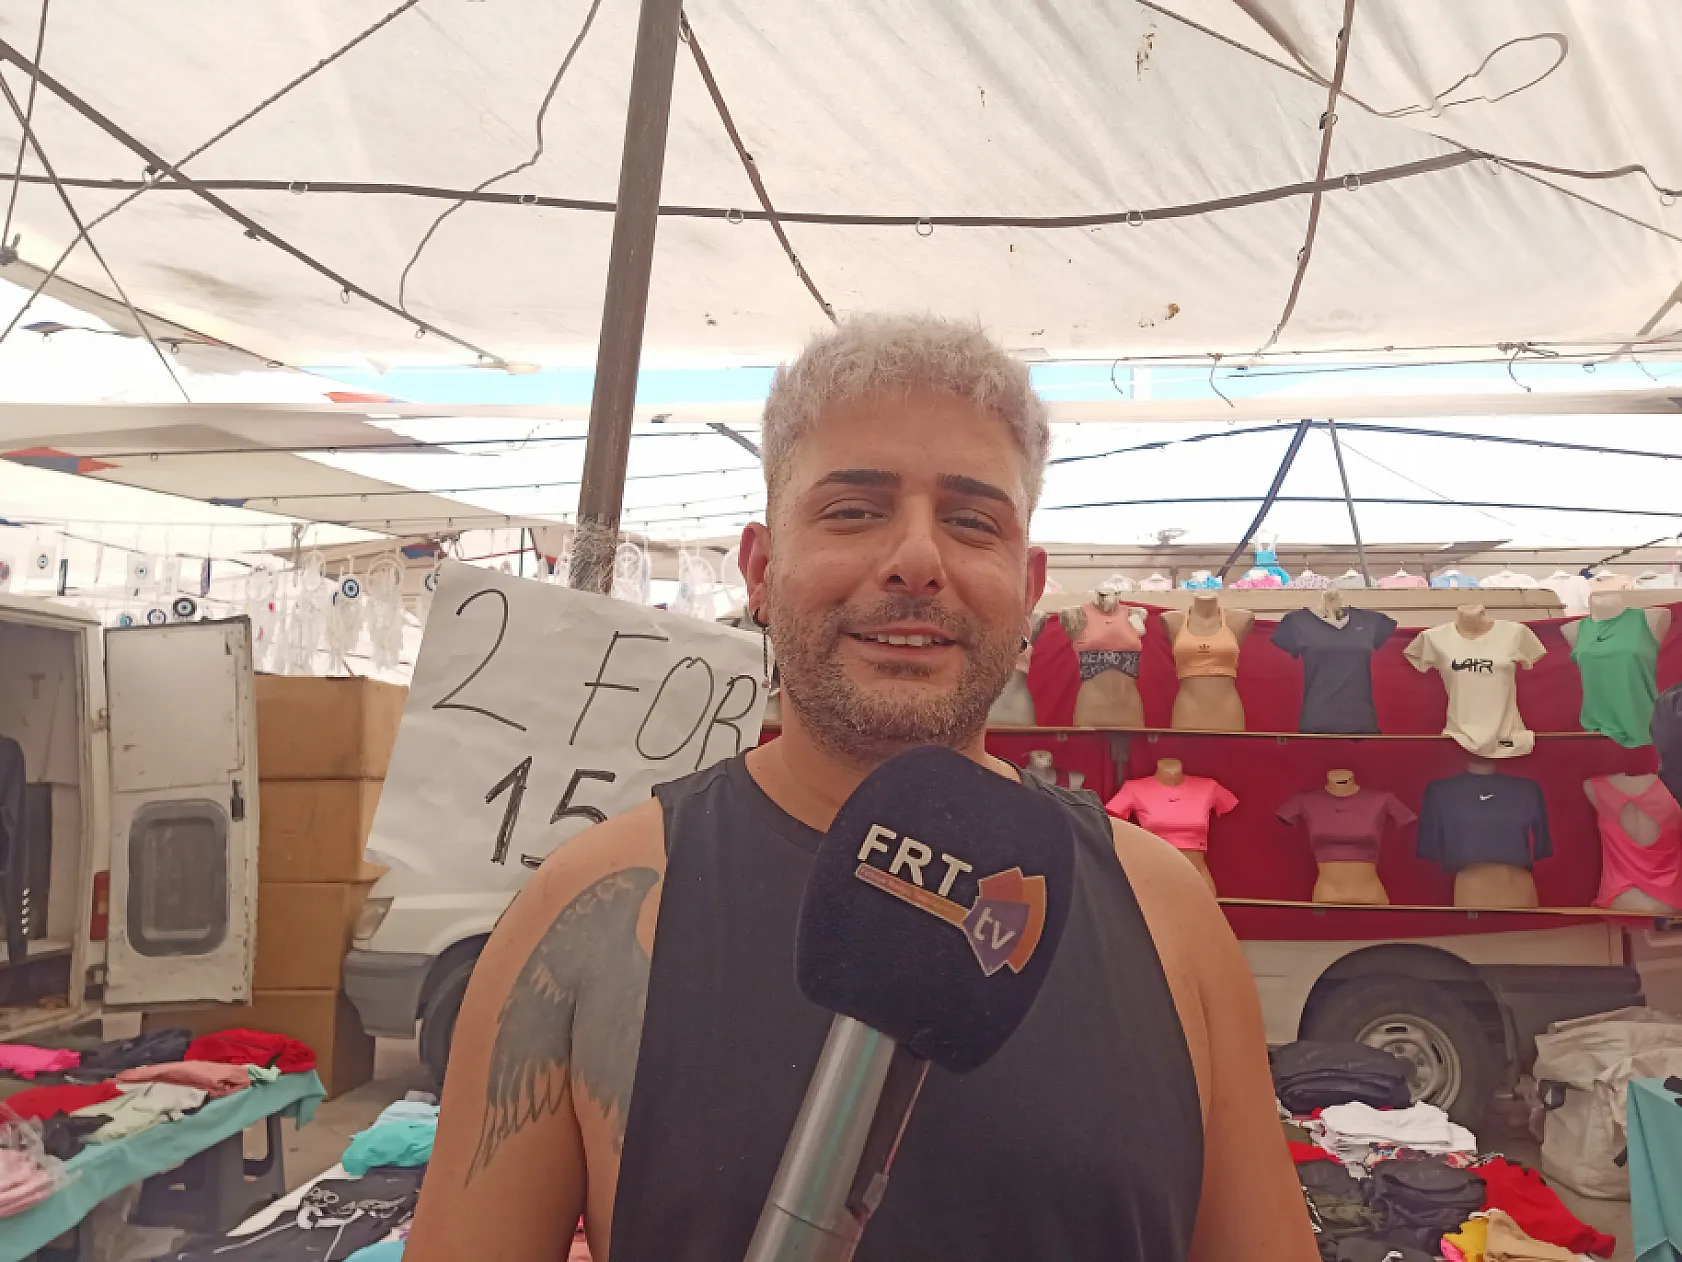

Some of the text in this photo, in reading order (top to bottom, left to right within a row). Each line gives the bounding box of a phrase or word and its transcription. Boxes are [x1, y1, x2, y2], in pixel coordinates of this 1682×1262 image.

[432, 588, 758, 771] 2 FOR
[484, 756, 617, 870] 15
[857, 823, 973, 897] FRT
[973, 906, 1016, 950] tv
